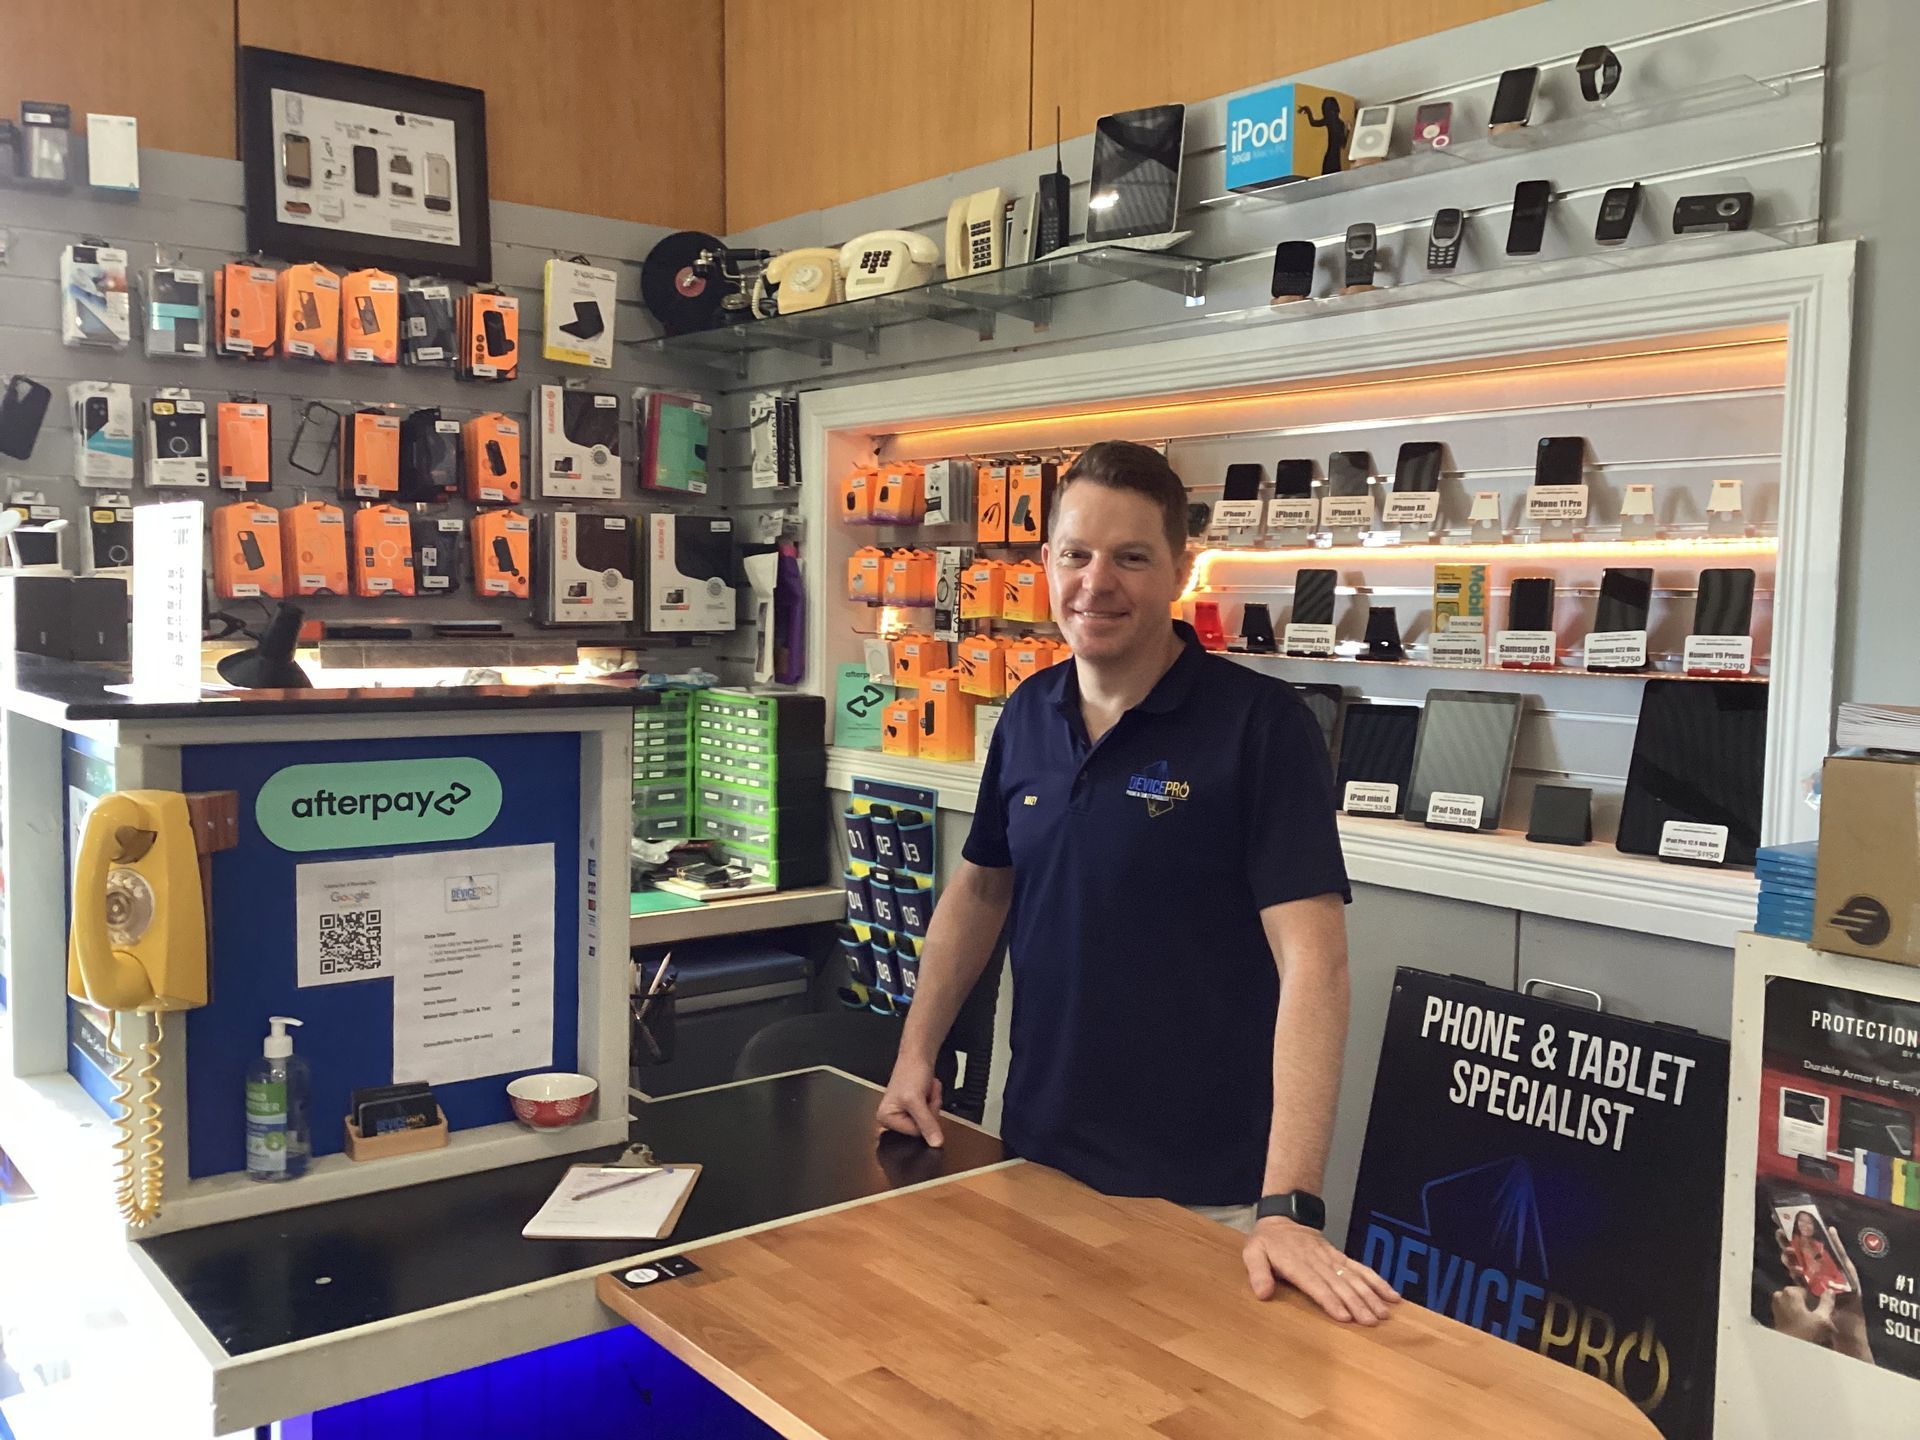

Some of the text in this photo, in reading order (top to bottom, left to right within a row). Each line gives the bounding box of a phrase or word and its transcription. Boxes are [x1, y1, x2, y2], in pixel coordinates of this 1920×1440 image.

[1232, 106, 1288, 153] iPod
[1223, 510, 1247, 518] iPhone
[1275, 510, 1303, 518] iPhone
[1391, 504, 1415, 512] iPhone
[1500, 645, 1550, 654] Samsung S8
[1621, 655, 1641, 663] $750
[1723, 662, 1746, 670] $290
[1128, 775, 1190, 798] DEVICEPRO
[1350, 793, 1366, 802] iPad
[1366, 795, 1384, 803] mini
[291, 789, 435, 821] afterpay
[1432, 805, 1477, 818] iPad 5th Gen
[847, 829, 921, 863] 01 02 03
[330, 890, 370, 903] Google
[847, 890, 920, 927] 04 05 06
[876, 960, 892, 983] 08
[902, 967, 917, 990] 09
[1811, 1010, 1918, 1048] PROTECTION
[1421, 995, 1696, 1106] PHONE & TABLET
[1803, 1060, 1841, 1076] Durable
[1842, 1069, 1873, 1083] Armor
[1875, 1075, 1891, 1087] for
[1450, 1059, 1635, 1152] SPECIALIST
[1895, 1274, 1915, 1295] #1
[1361, 1223, 1670, 1413] DEVICEPRO
[1879, 1292, 1920, 1321] PROT
